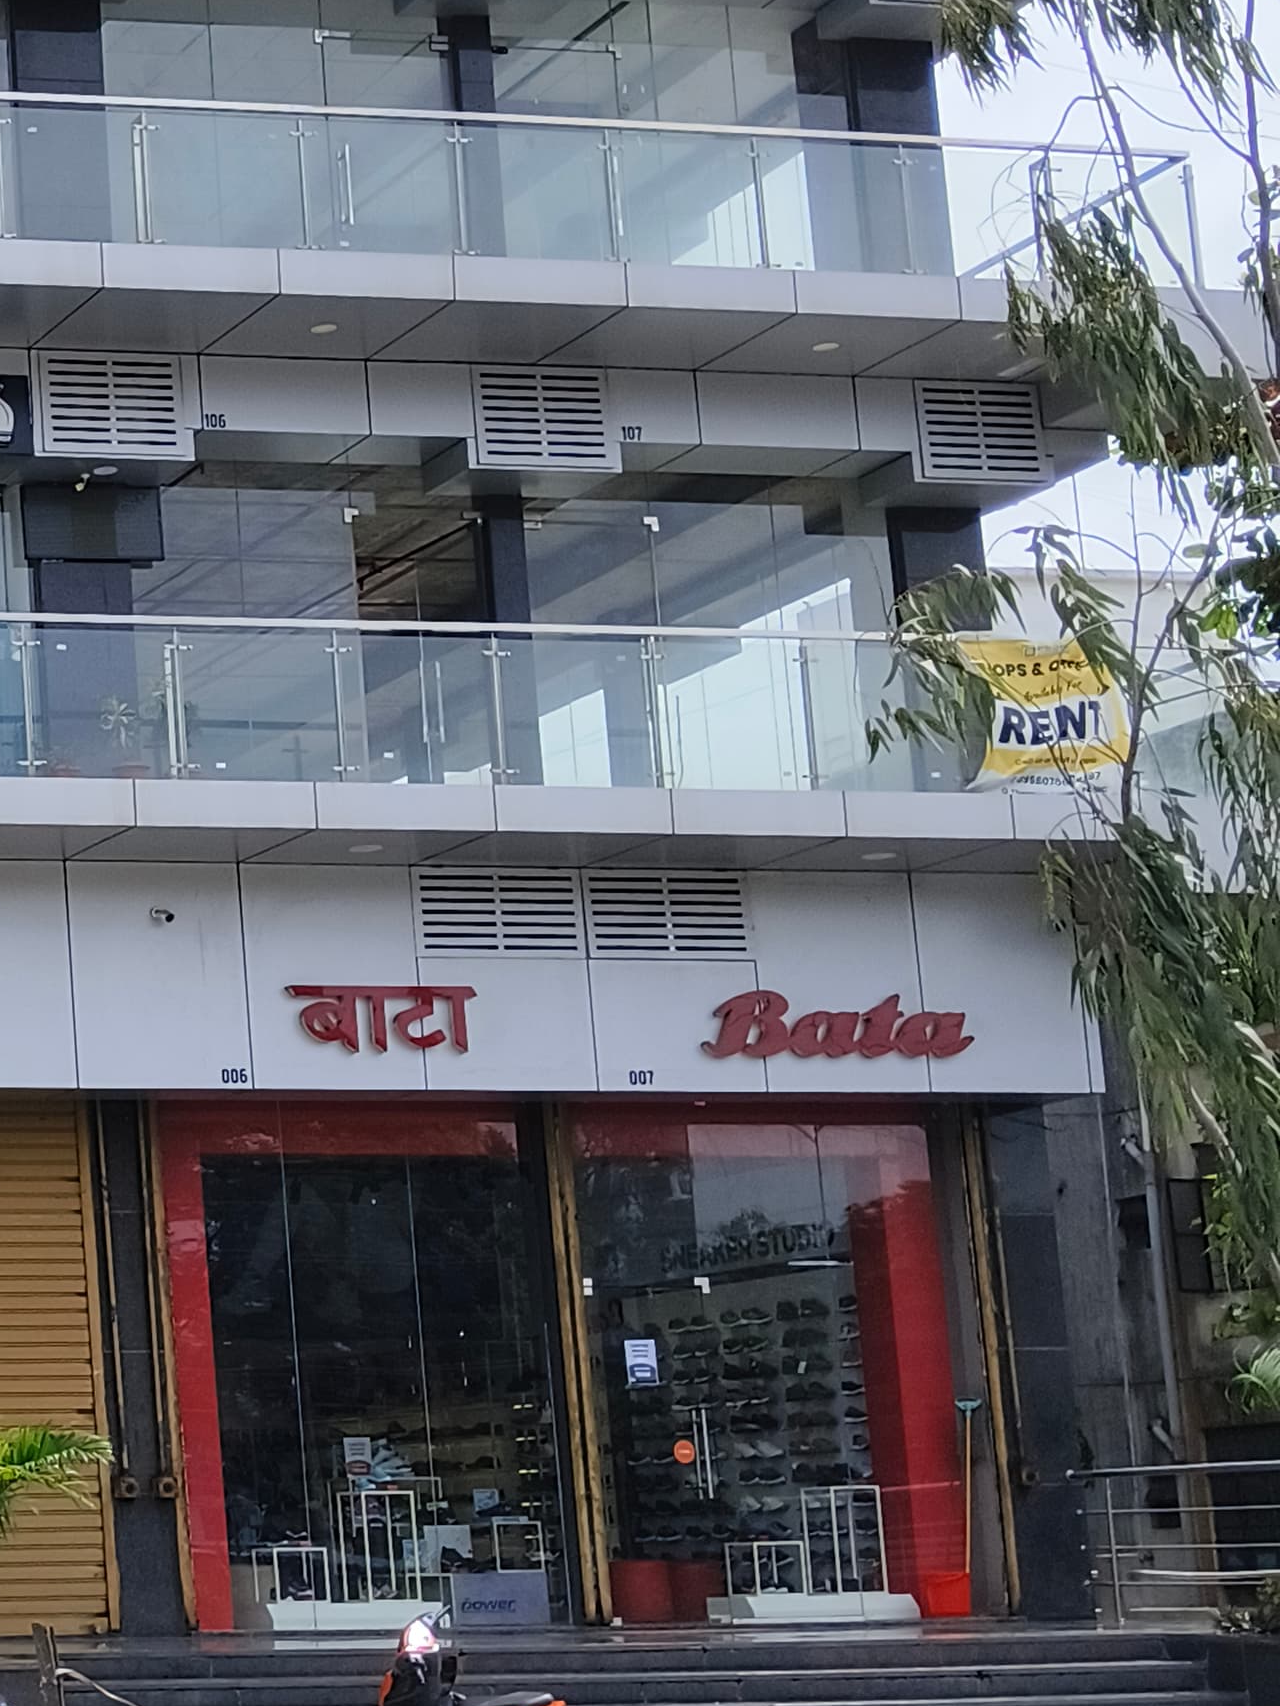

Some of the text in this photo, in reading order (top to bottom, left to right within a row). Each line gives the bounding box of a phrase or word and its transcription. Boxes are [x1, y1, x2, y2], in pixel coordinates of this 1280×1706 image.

[203, 413, 227, 429] 106
[620, 424, 643, 442] 107
[1032, 663, 1044, 676] &
[998, 701, 1102, 746] RENT
[285, 983, 478, 1056] बाटा
[699, 987, 979, 1061] Bata
[220, 1067, 248, 1086] 006
[627, 1069, 655, 1087] 007
[461, 1597, 516, 1612] power
